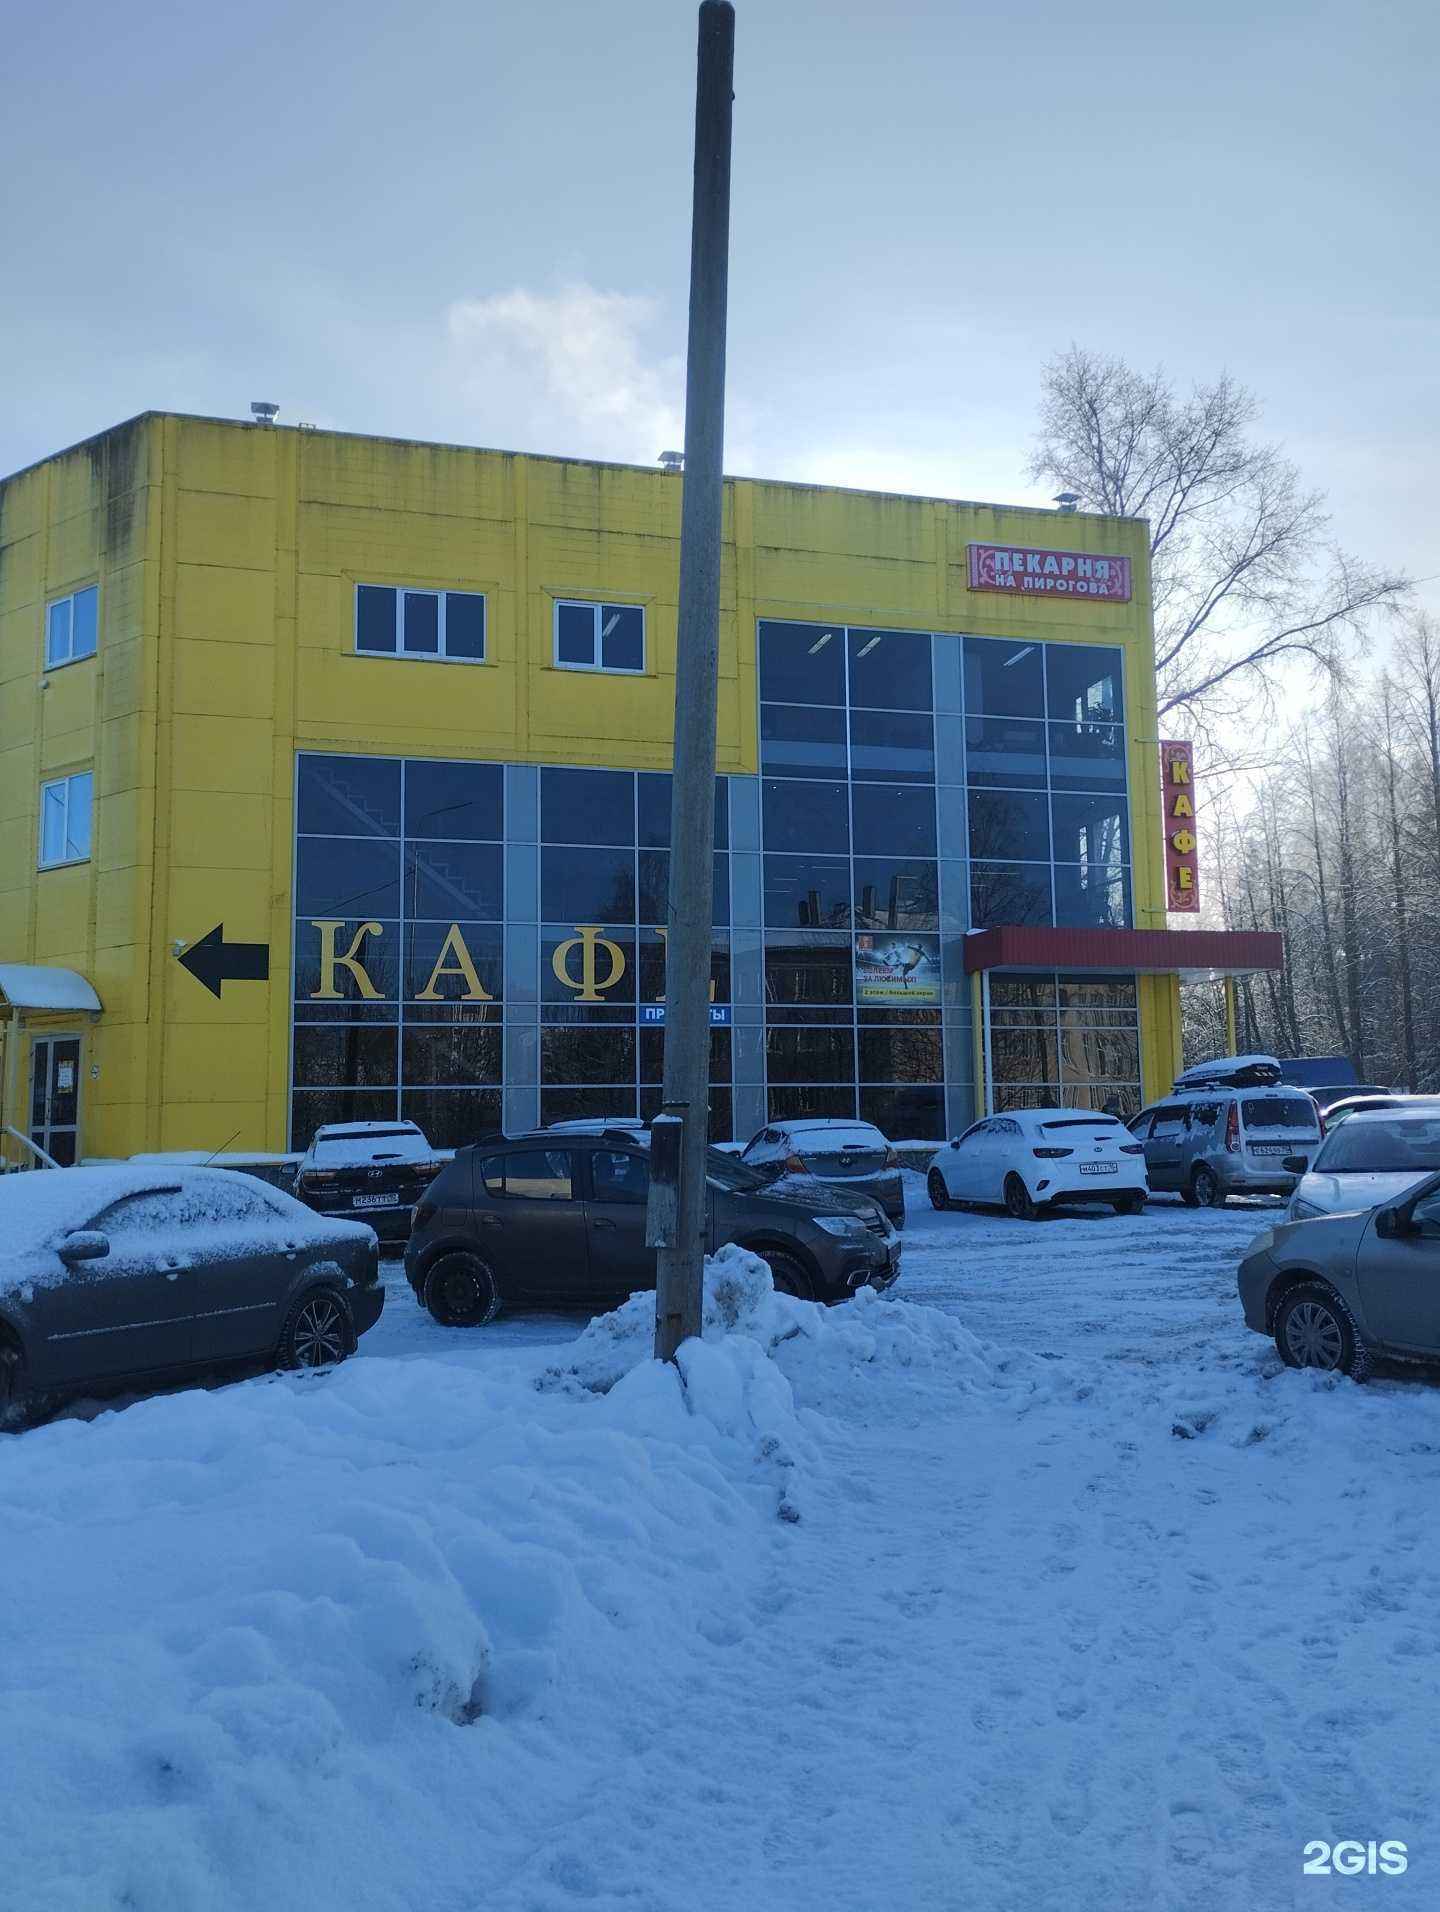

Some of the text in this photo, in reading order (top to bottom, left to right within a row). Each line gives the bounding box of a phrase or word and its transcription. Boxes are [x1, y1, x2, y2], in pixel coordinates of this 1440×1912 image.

[994, 551, 1111, 580] ПЕКАРНЯ
[995, 575, 1110, 594] НА ПИРОГОВА
[1171, 760, 1197, 890] КАФЕ
[311, 920, 716, 1002] КАФ
